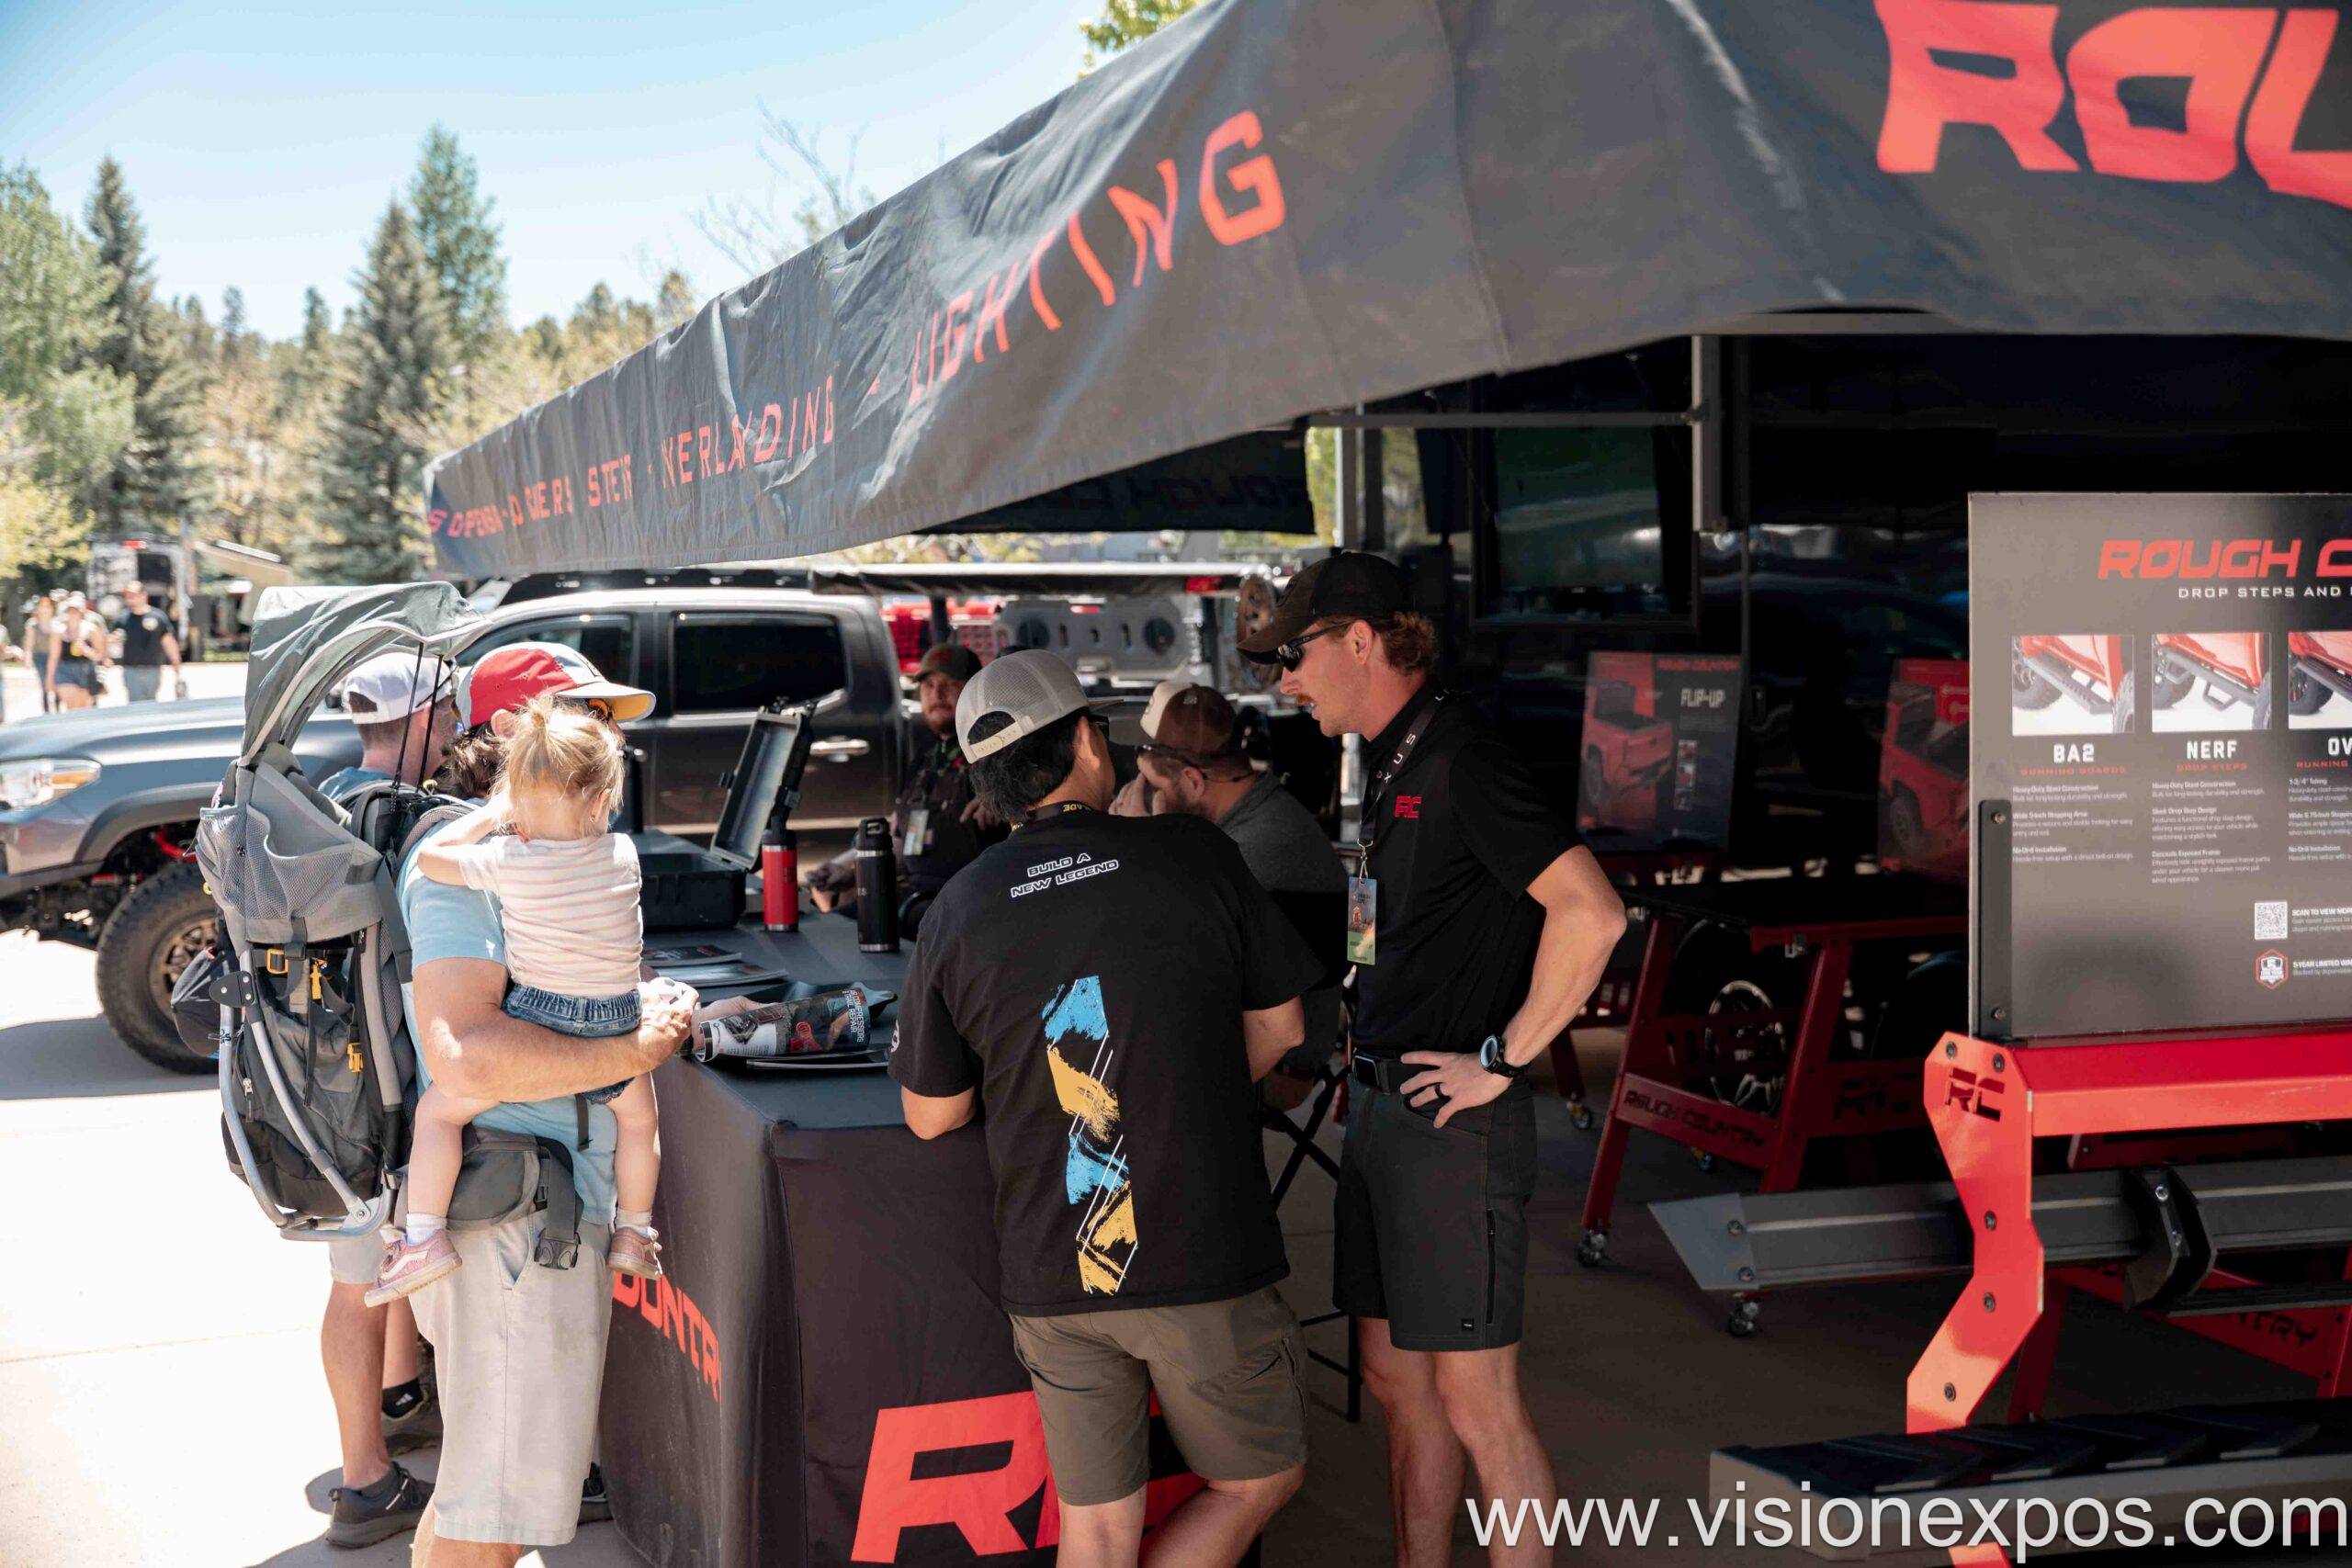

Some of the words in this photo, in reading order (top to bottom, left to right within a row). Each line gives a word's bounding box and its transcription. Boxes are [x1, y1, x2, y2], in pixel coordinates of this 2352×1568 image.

[2098, 538, 2302, 580] ROUGH
[2178, 586, 2230, 599] DROP
[2236, 585, 2296, 598] STEPS
[2302, 585, 2343, 597] AND
[2052, 742, 2096, 764] BA2
[2186, 739, 2238, 761] NERF
[2295, 760, 2349, 769] RUNNING
[1394, 795, 1423, 819] RC
[1027, 856, 1073, 878] BUILD
[1076, 852, 1091, 864] A
[1010, 877, 1052, 898] NEW
[1055, 859, 1119, 886] LEGEND
[2291, 908, 2311, 917] SCAN
[848, 1009, 858, 1033] REPAIR
[1944, 1066, 2005, 1122] RC
[612, 1269, 722, 1404] OUNTR
